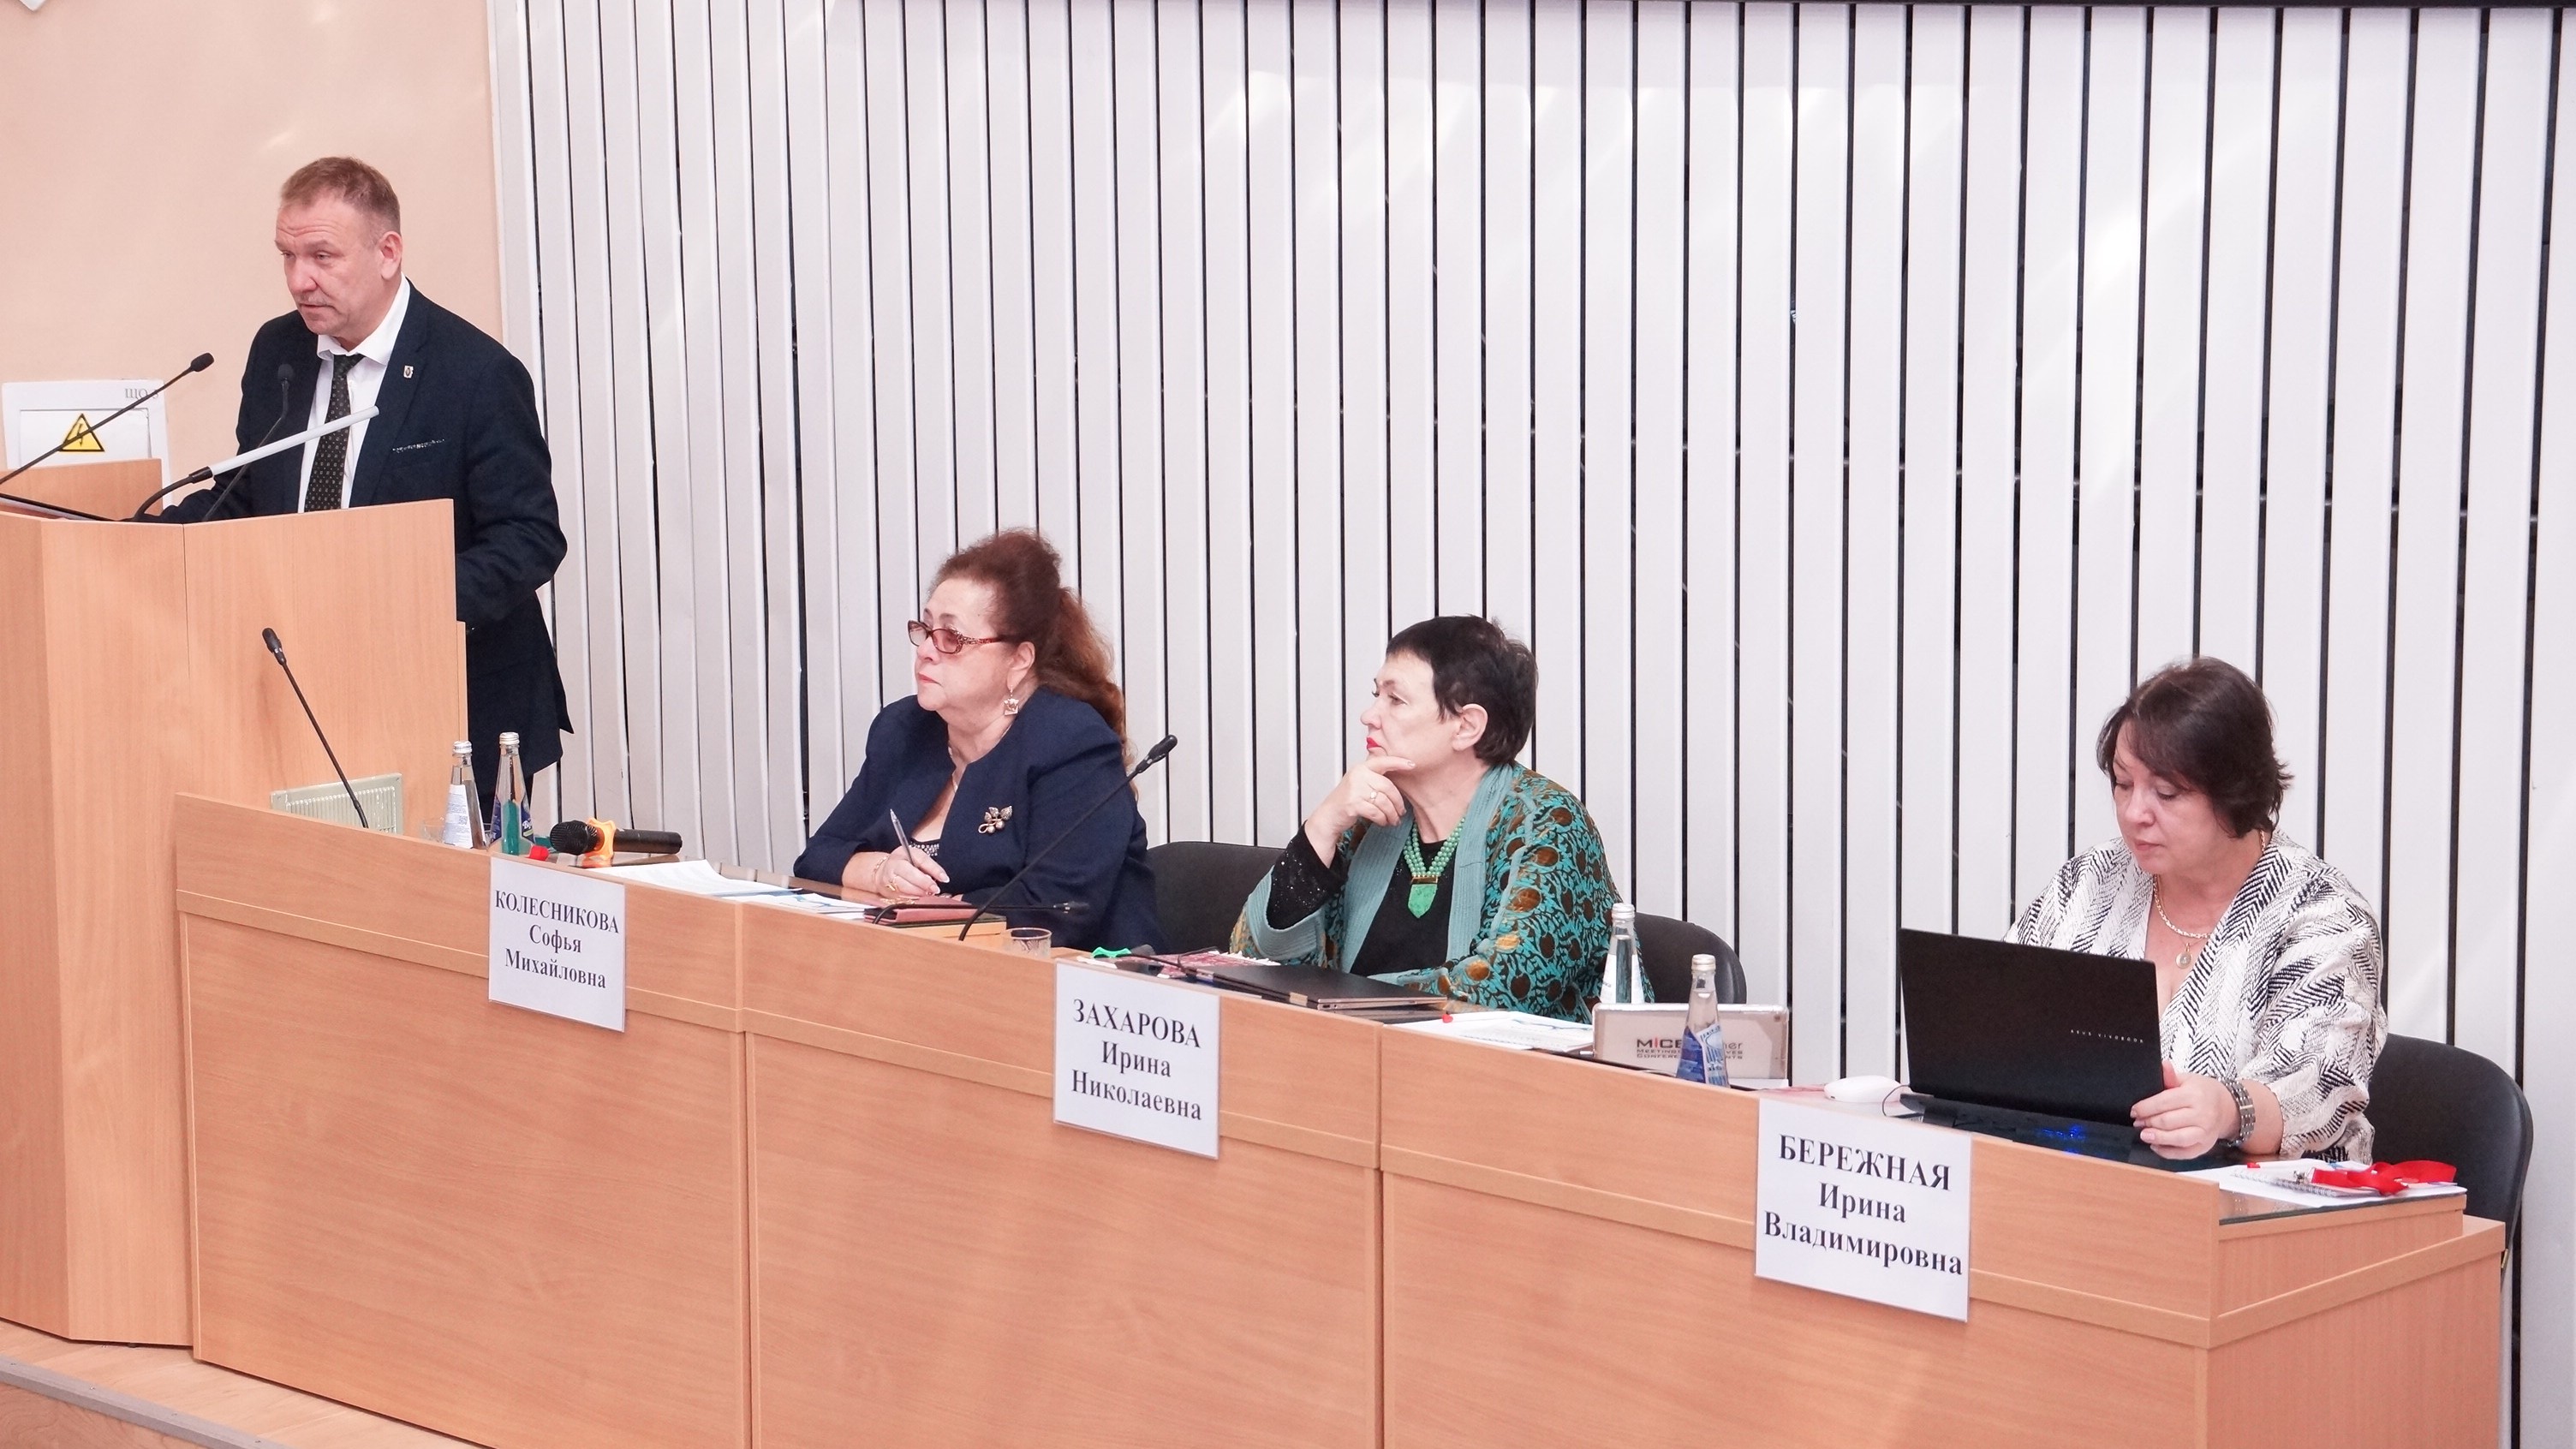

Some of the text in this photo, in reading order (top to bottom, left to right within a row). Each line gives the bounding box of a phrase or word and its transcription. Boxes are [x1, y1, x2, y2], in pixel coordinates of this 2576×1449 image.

[495, 890, 619, 933] КОЛЕСНИКОВА
[529, 924, 581, 954] Софья
[505, 948, 606, 988] Михайловна
[1073, 999, 1201, 1048] ЗАХАРОВА
[1101, 1040, 1171, 1078] Ирина
[1071, 1069, 1202, 1120] Николаевна
[1779, 1134, 1951, 1191] БЕРЕЖНАЯ
[1819, 1181, 1906, 1224] Ирина
[1764, 1210, 1963, 1275] Владимировна
